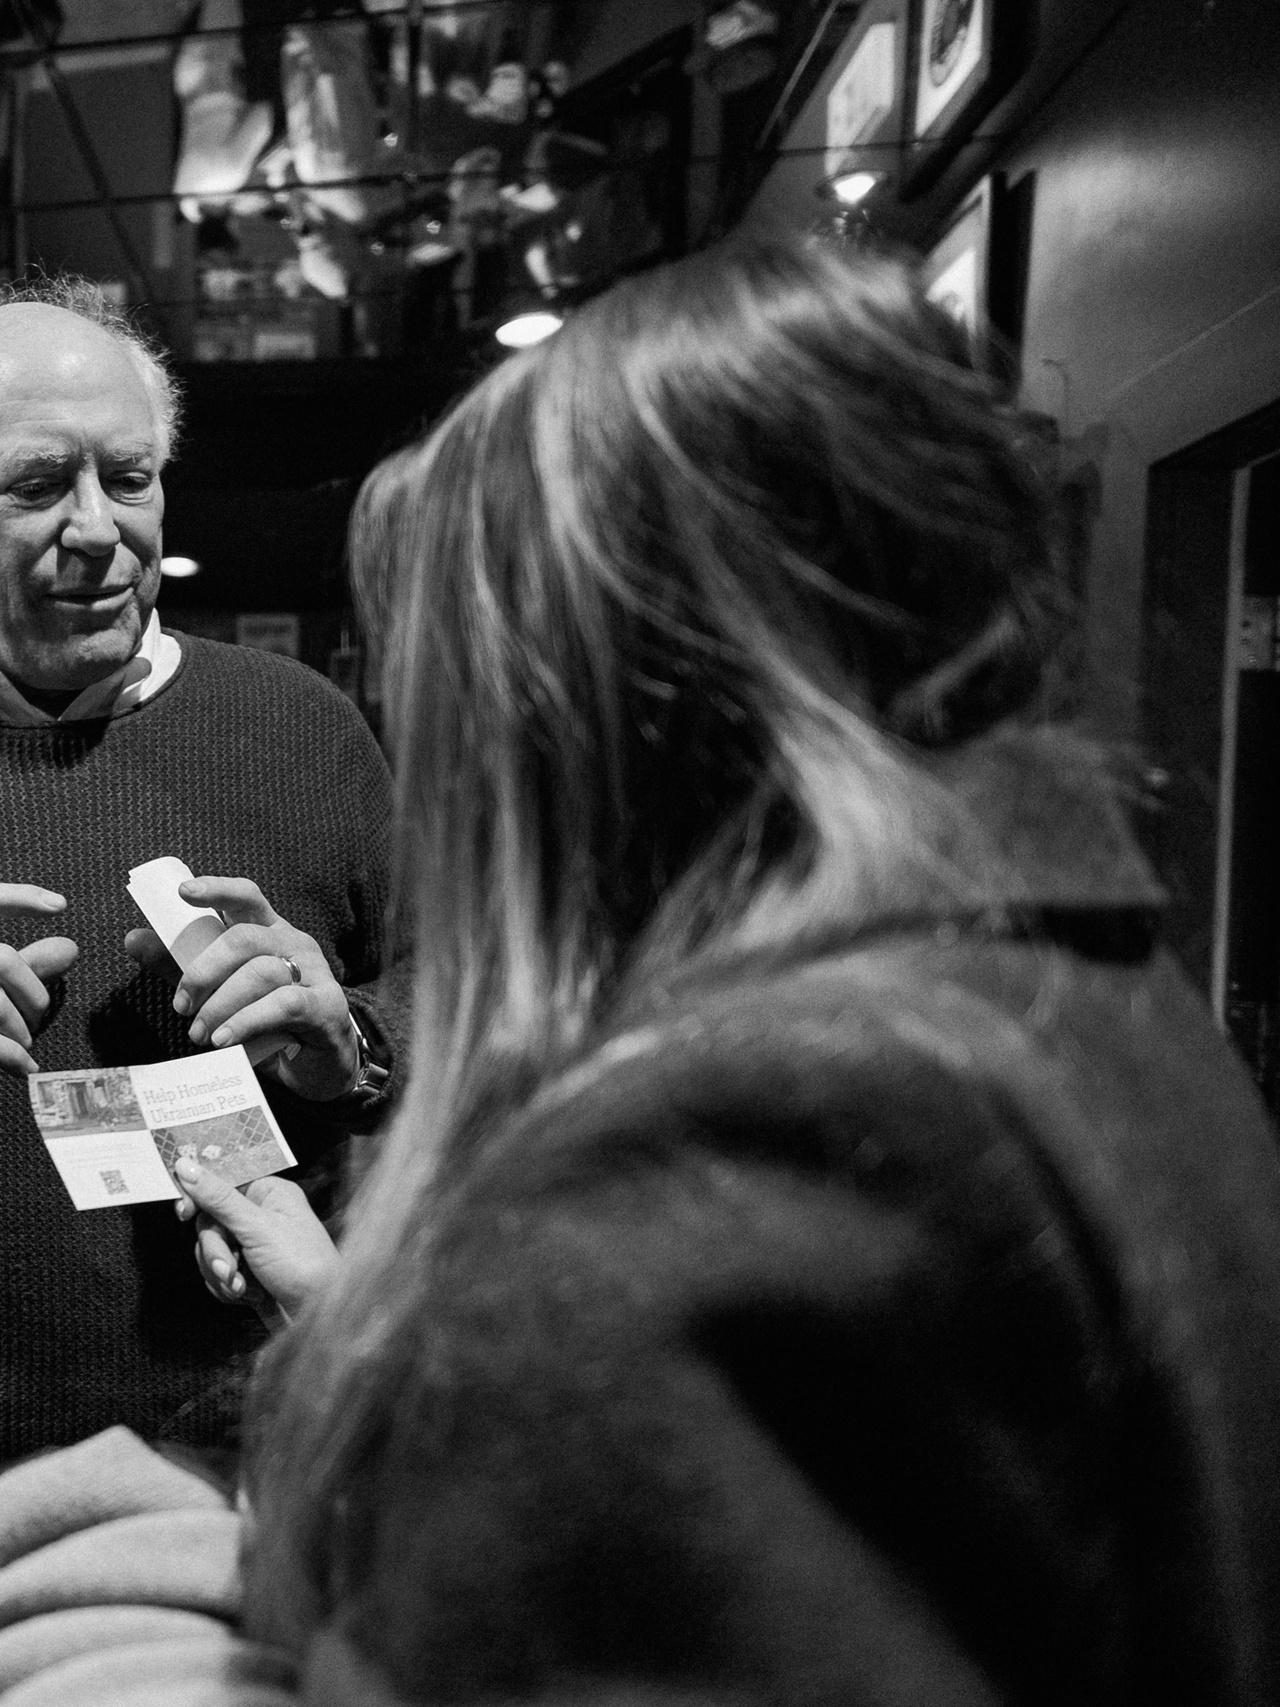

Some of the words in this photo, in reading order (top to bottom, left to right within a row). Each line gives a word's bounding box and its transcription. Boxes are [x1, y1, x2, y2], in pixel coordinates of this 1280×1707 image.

[143, 1088, 176, 1105] Help
[177, 1075, 243, 1099] Homeless
[150, 1102, 216, 1123] Ukrainian
[216, 1094, 247, 1110] Pets
